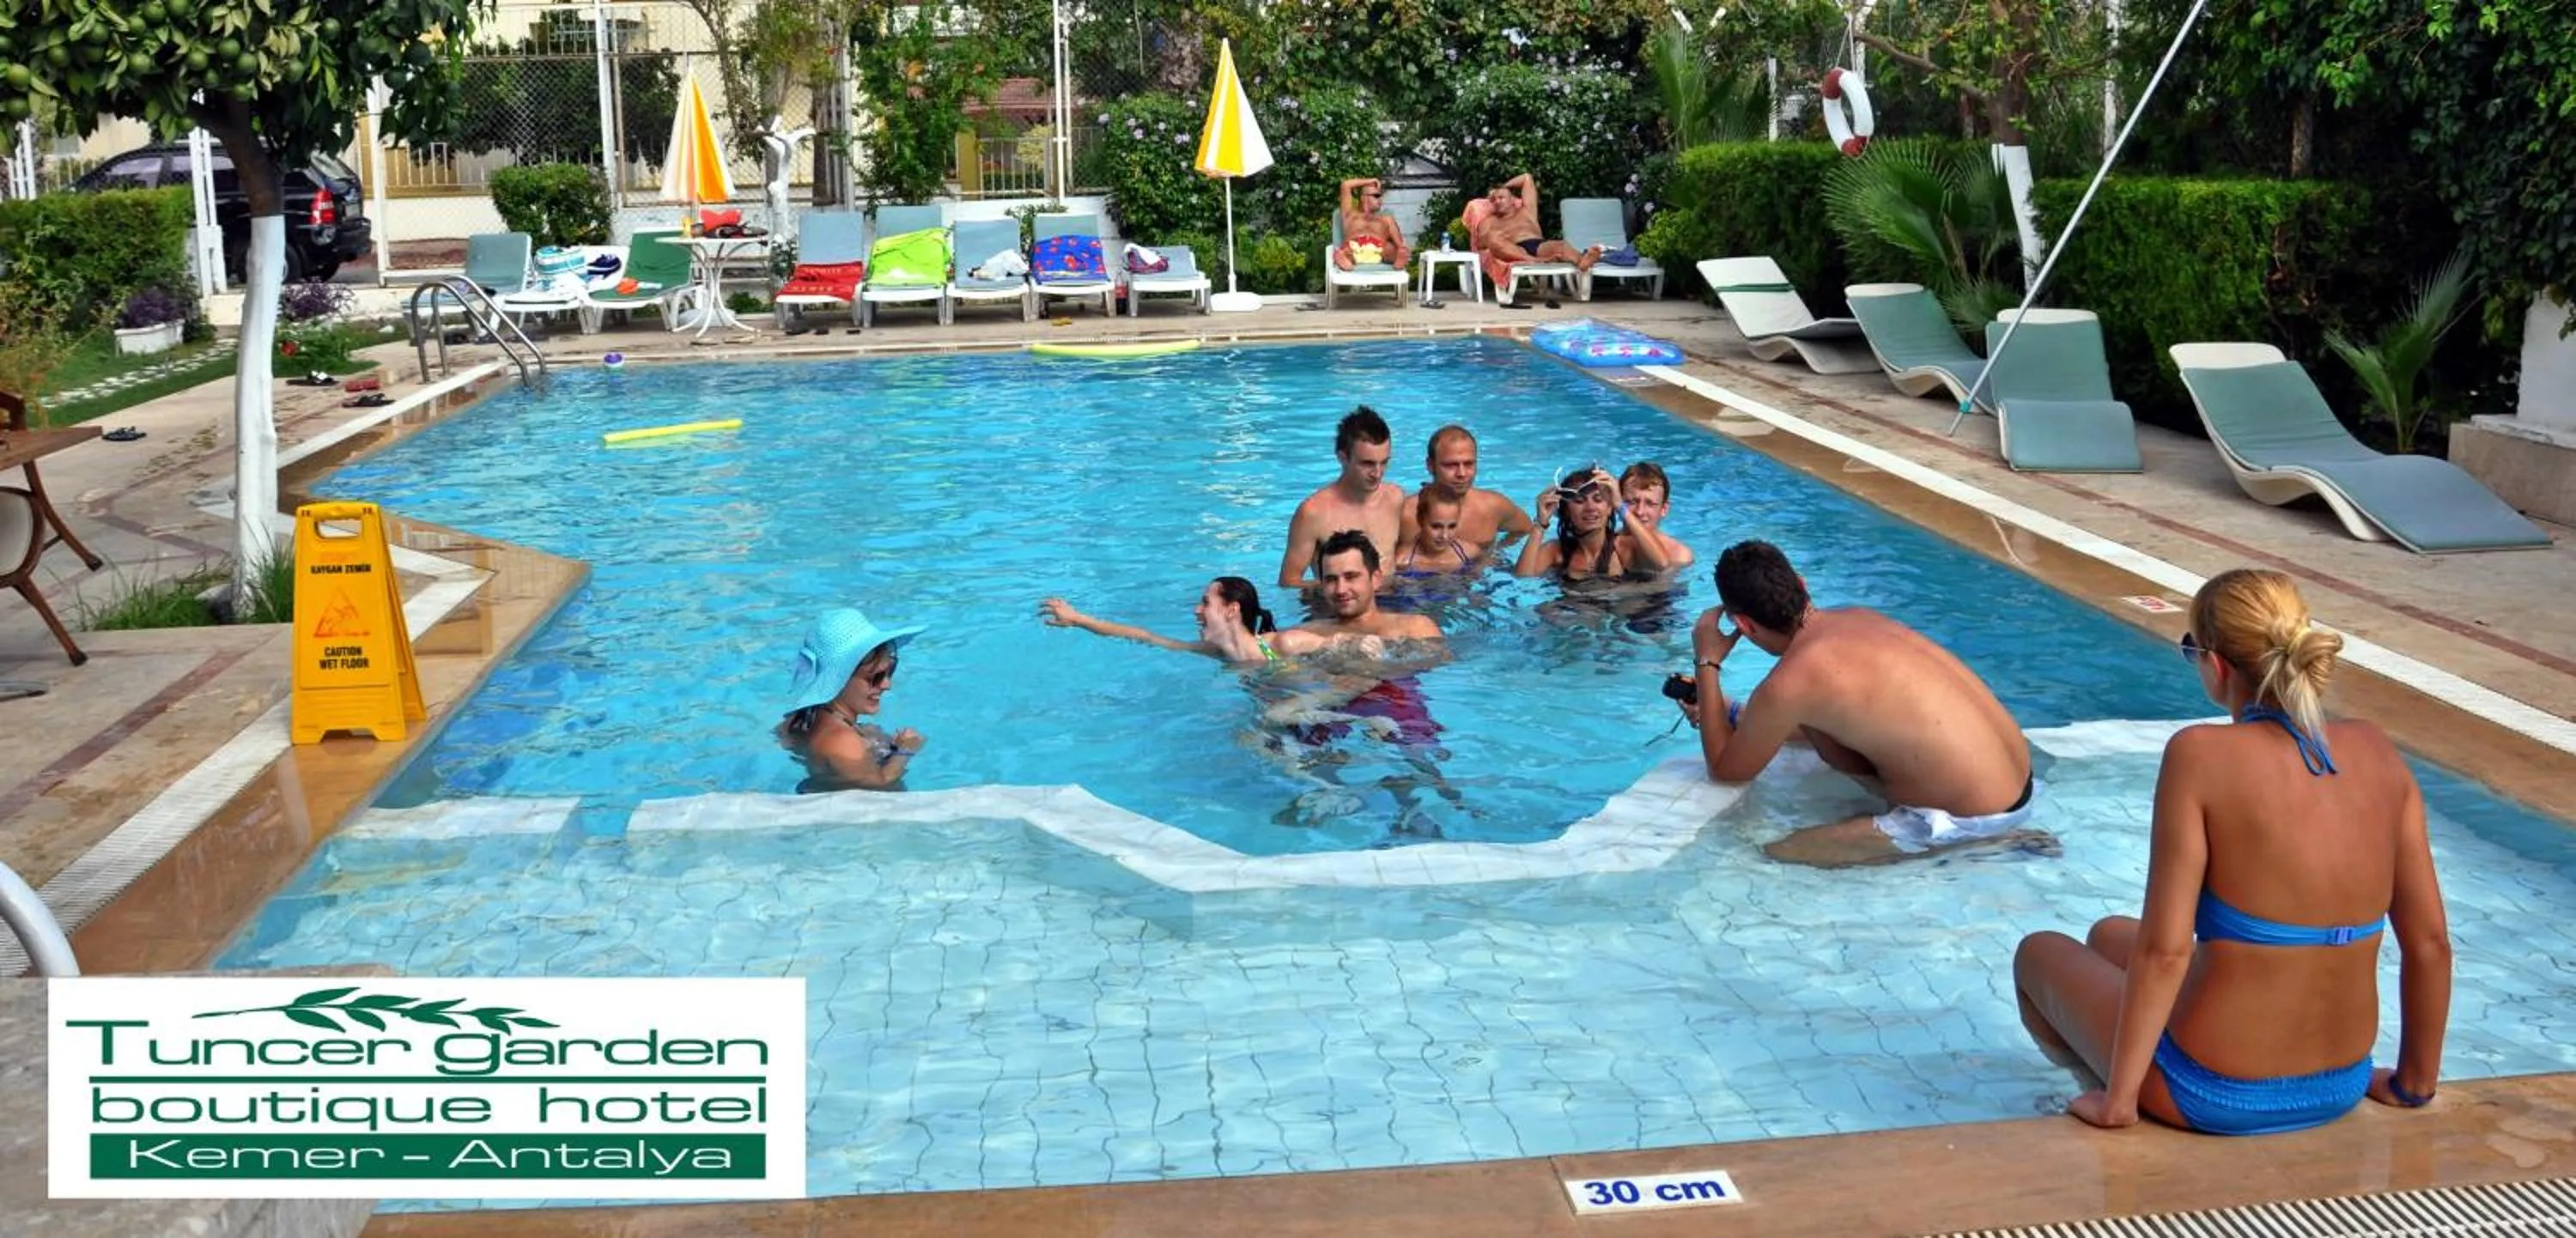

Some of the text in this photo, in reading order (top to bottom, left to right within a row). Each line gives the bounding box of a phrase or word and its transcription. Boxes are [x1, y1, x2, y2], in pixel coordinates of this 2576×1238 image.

[324, 646, 362, 658] CAUTION
[319, 657, 369, 670] WET FLOOR
[1584, 1180, 1726, 1205] 30 cm
